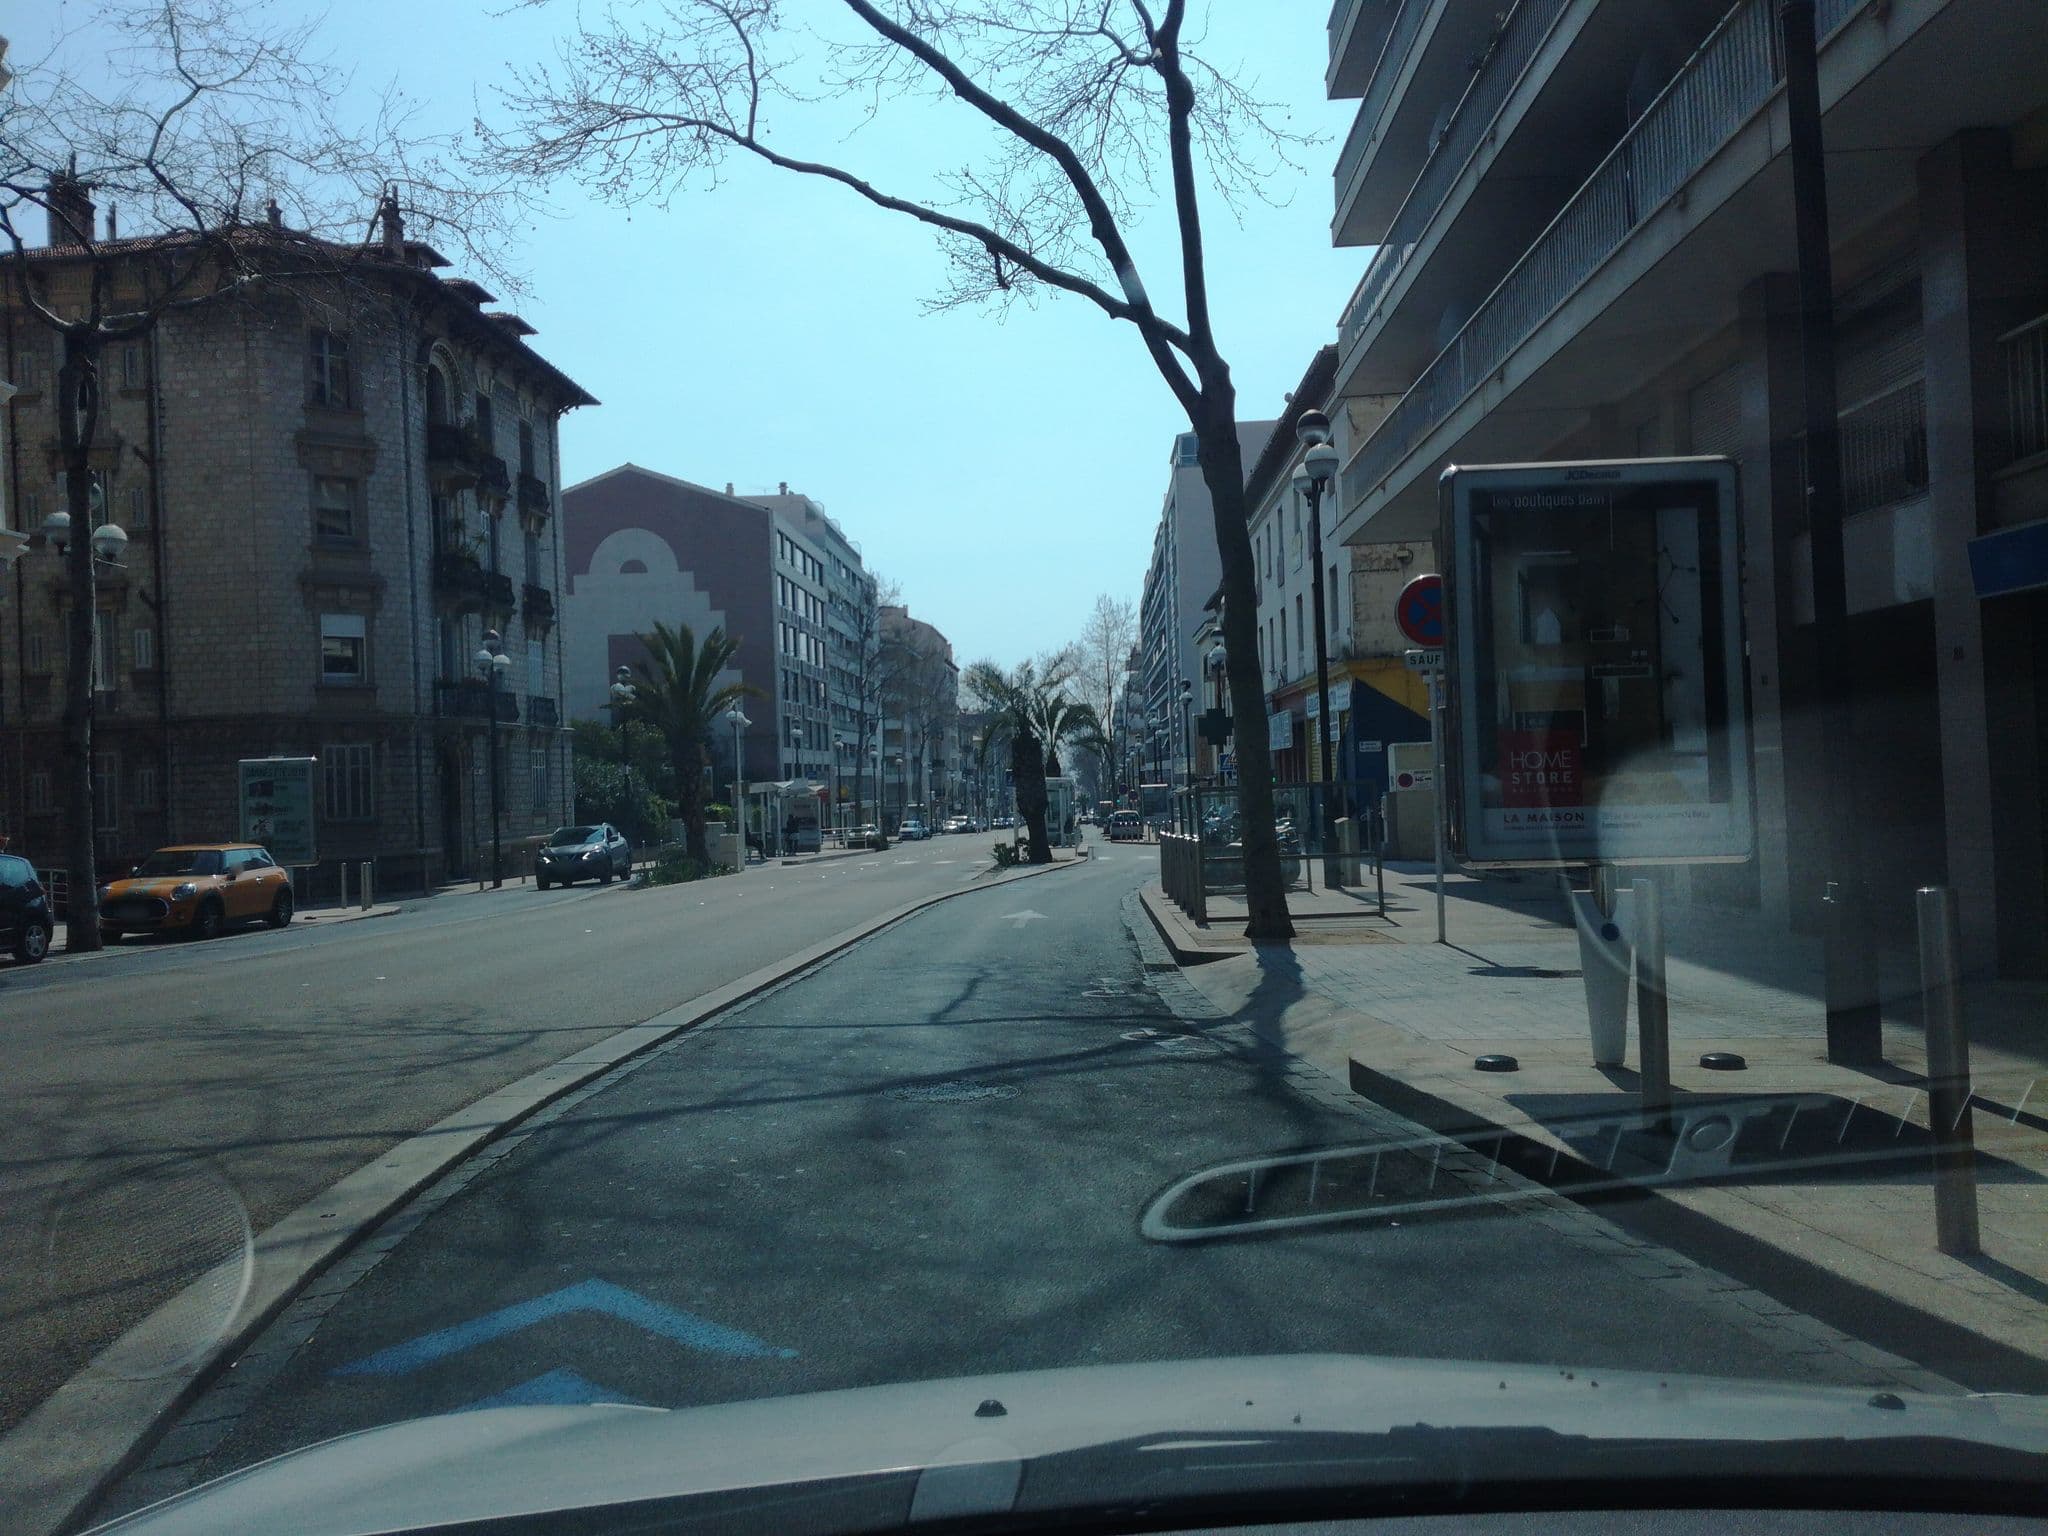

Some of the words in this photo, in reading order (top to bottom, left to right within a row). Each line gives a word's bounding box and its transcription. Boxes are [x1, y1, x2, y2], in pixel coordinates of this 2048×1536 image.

[1410, 654, 1441, 665] SAUF
[1510, 751, 1573, 769] HOME
[1512, 771, 1573, 785] STORE
[1504, 813, 1520, 824] LA
[1527, 811, 1585, 823] MAISON
